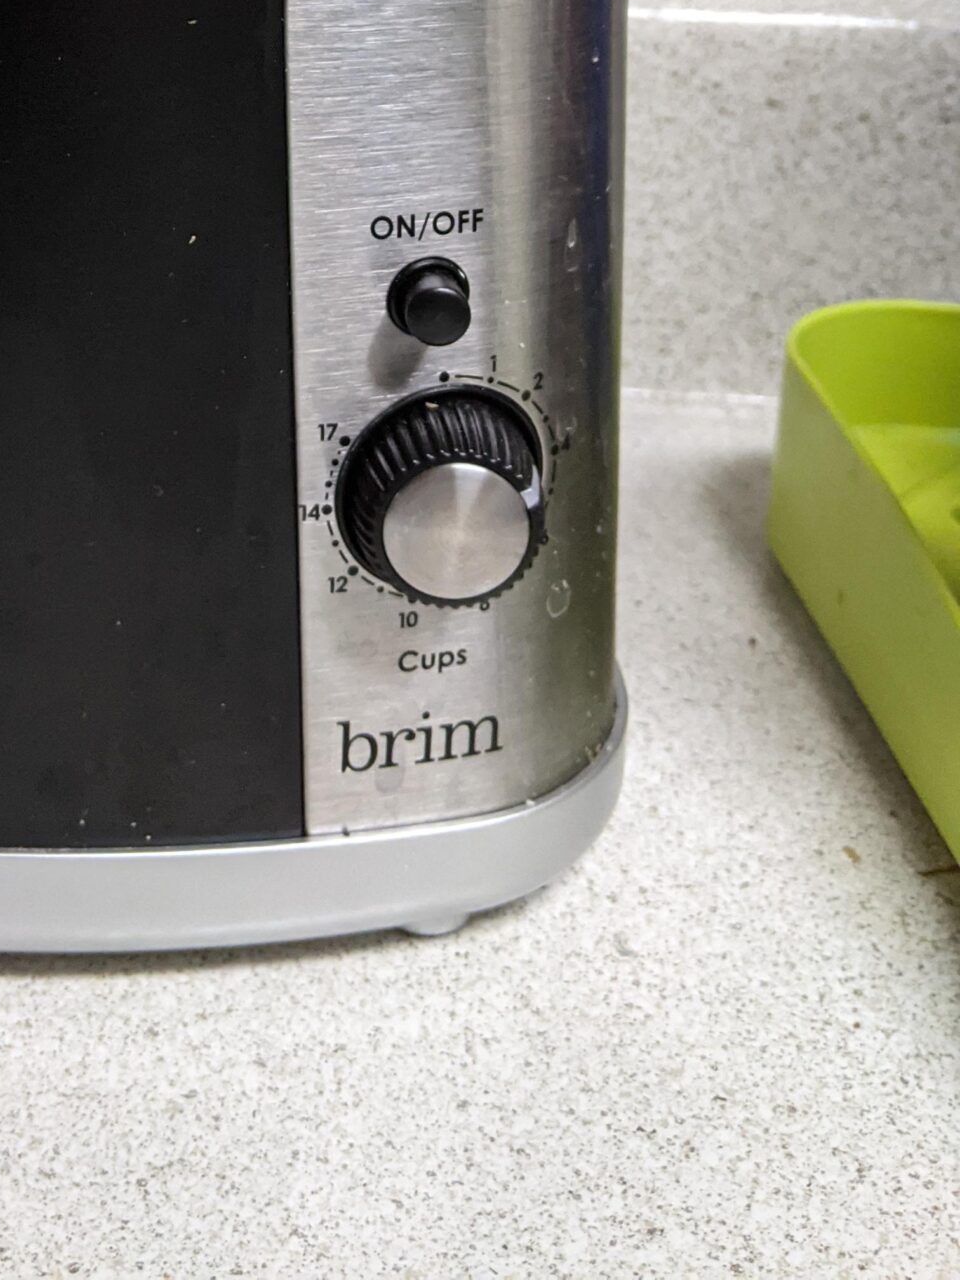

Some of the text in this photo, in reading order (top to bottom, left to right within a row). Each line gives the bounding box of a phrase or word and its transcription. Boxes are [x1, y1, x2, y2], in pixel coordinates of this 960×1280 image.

[370, 208, 484, 241] ON/OFF
[489, 354, 498, 372] 1
[533, 371, 544, 391] 2
[317, 423, 338, 442] 17
[298, 503, 321, 521] 14
[327, 576, 348, 594] 12
[398, 611, 418, 629] 10
[397, 648, 468, 673] Cups
[337, 711, 503, 773] brim
